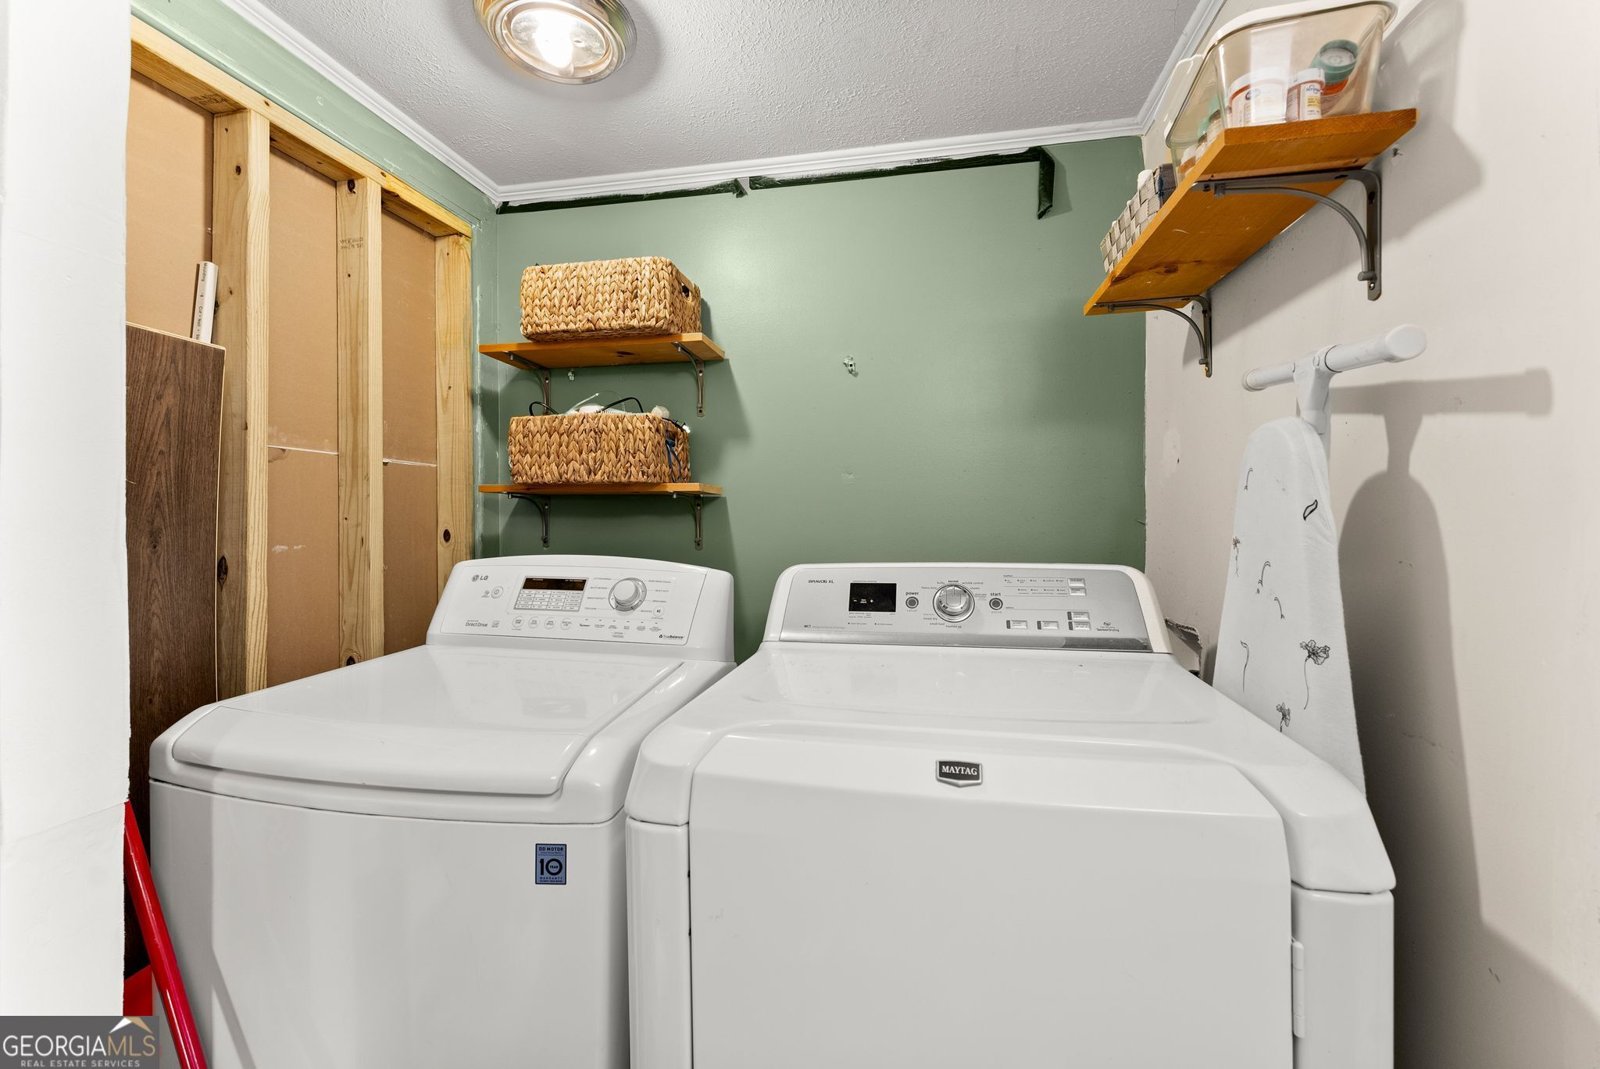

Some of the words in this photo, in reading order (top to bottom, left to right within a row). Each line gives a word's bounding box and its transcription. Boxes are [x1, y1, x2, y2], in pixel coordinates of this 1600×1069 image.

[479, 574, 489, 582] LG
[941, 765, 978, 776] MAYTAG
[539, 858, 563, 876] 10
